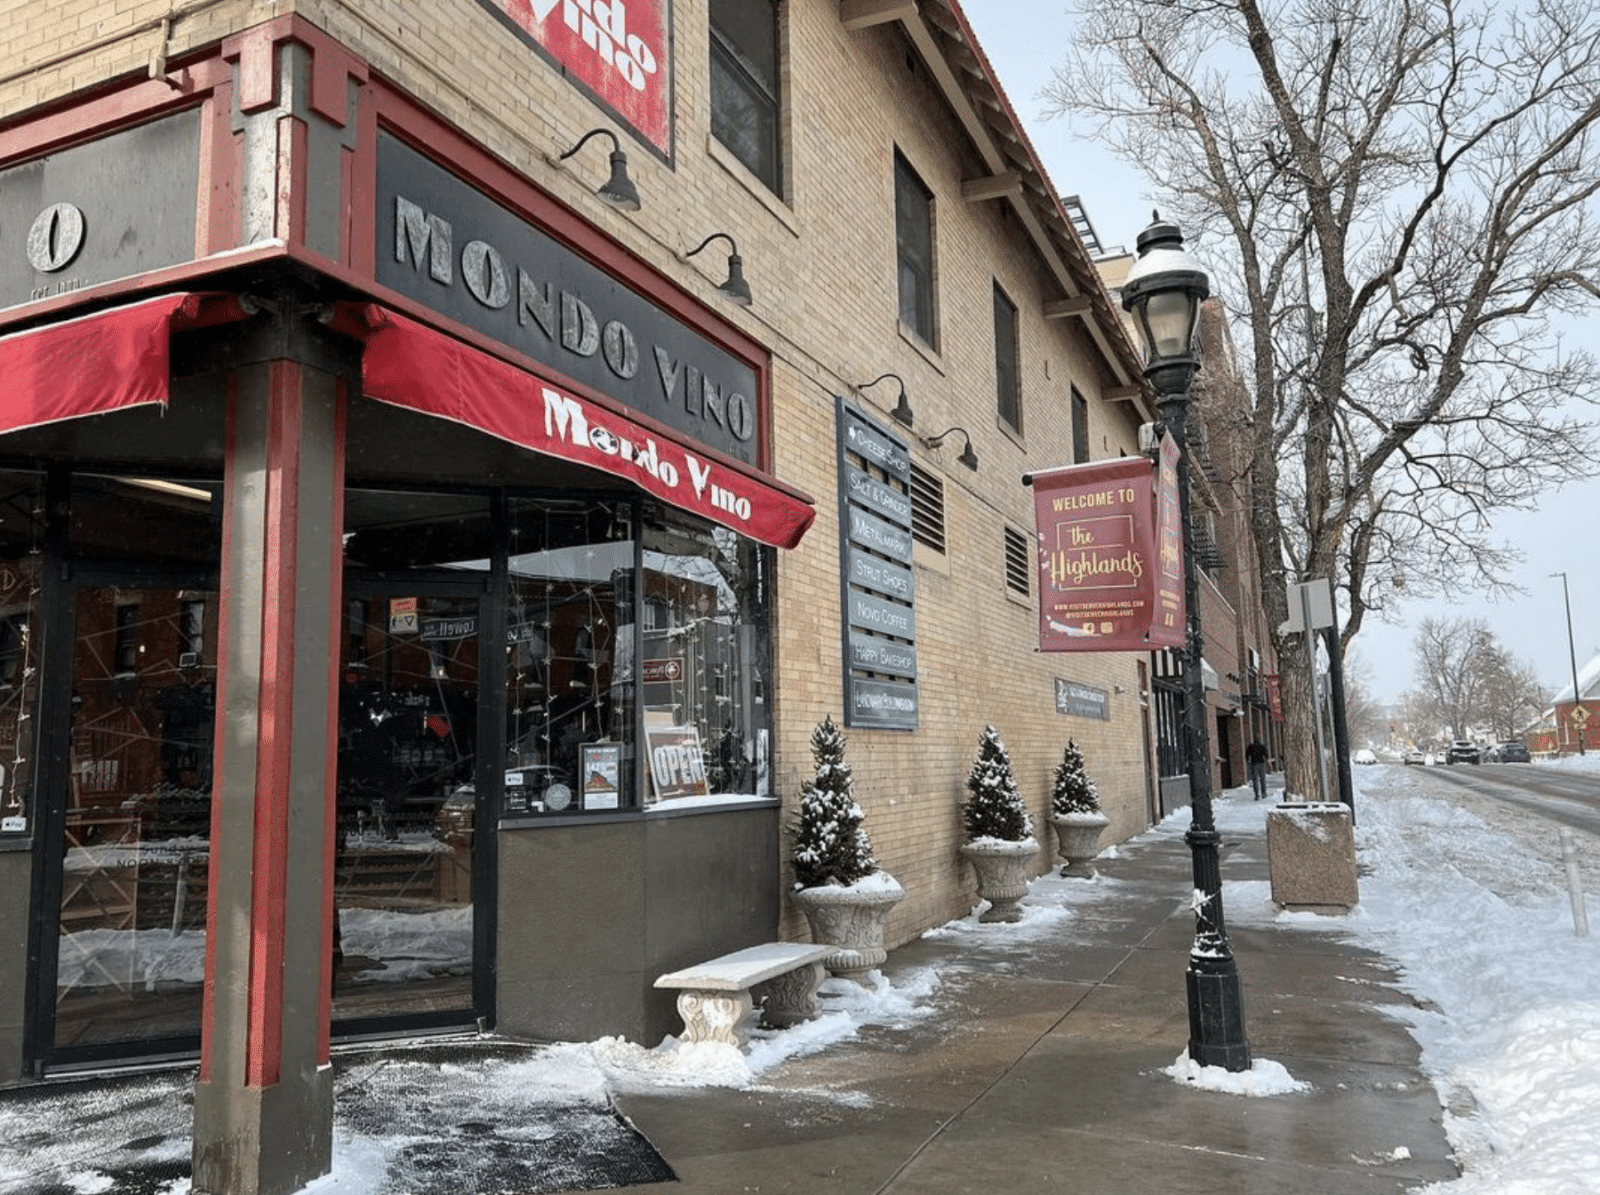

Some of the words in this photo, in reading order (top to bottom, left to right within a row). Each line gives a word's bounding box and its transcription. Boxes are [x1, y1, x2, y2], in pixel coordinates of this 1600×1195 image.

[394, 195, 639, 380] MONDO
[653, 344, 753, 442] VINO
[542, 387, 679, 488] Mondo
[685, 454, 751, 521] Vino
[850, 472, 871, 497] SALT
[1053, 490, 1114, 512] WELCOME
[1118, 488, 1135, 503] TO
[1066, 525, 1094, 546] the
[856, 559, 881, 582] STRUT
[883, 569, 907, 593] SHOES
[1051, 550, 1144, 585] Highlands
[882, 608, 907, 630] COFFEE
[855, 645, 878, 662] HAPPY
[654, 744, 704, 787] OPEN
